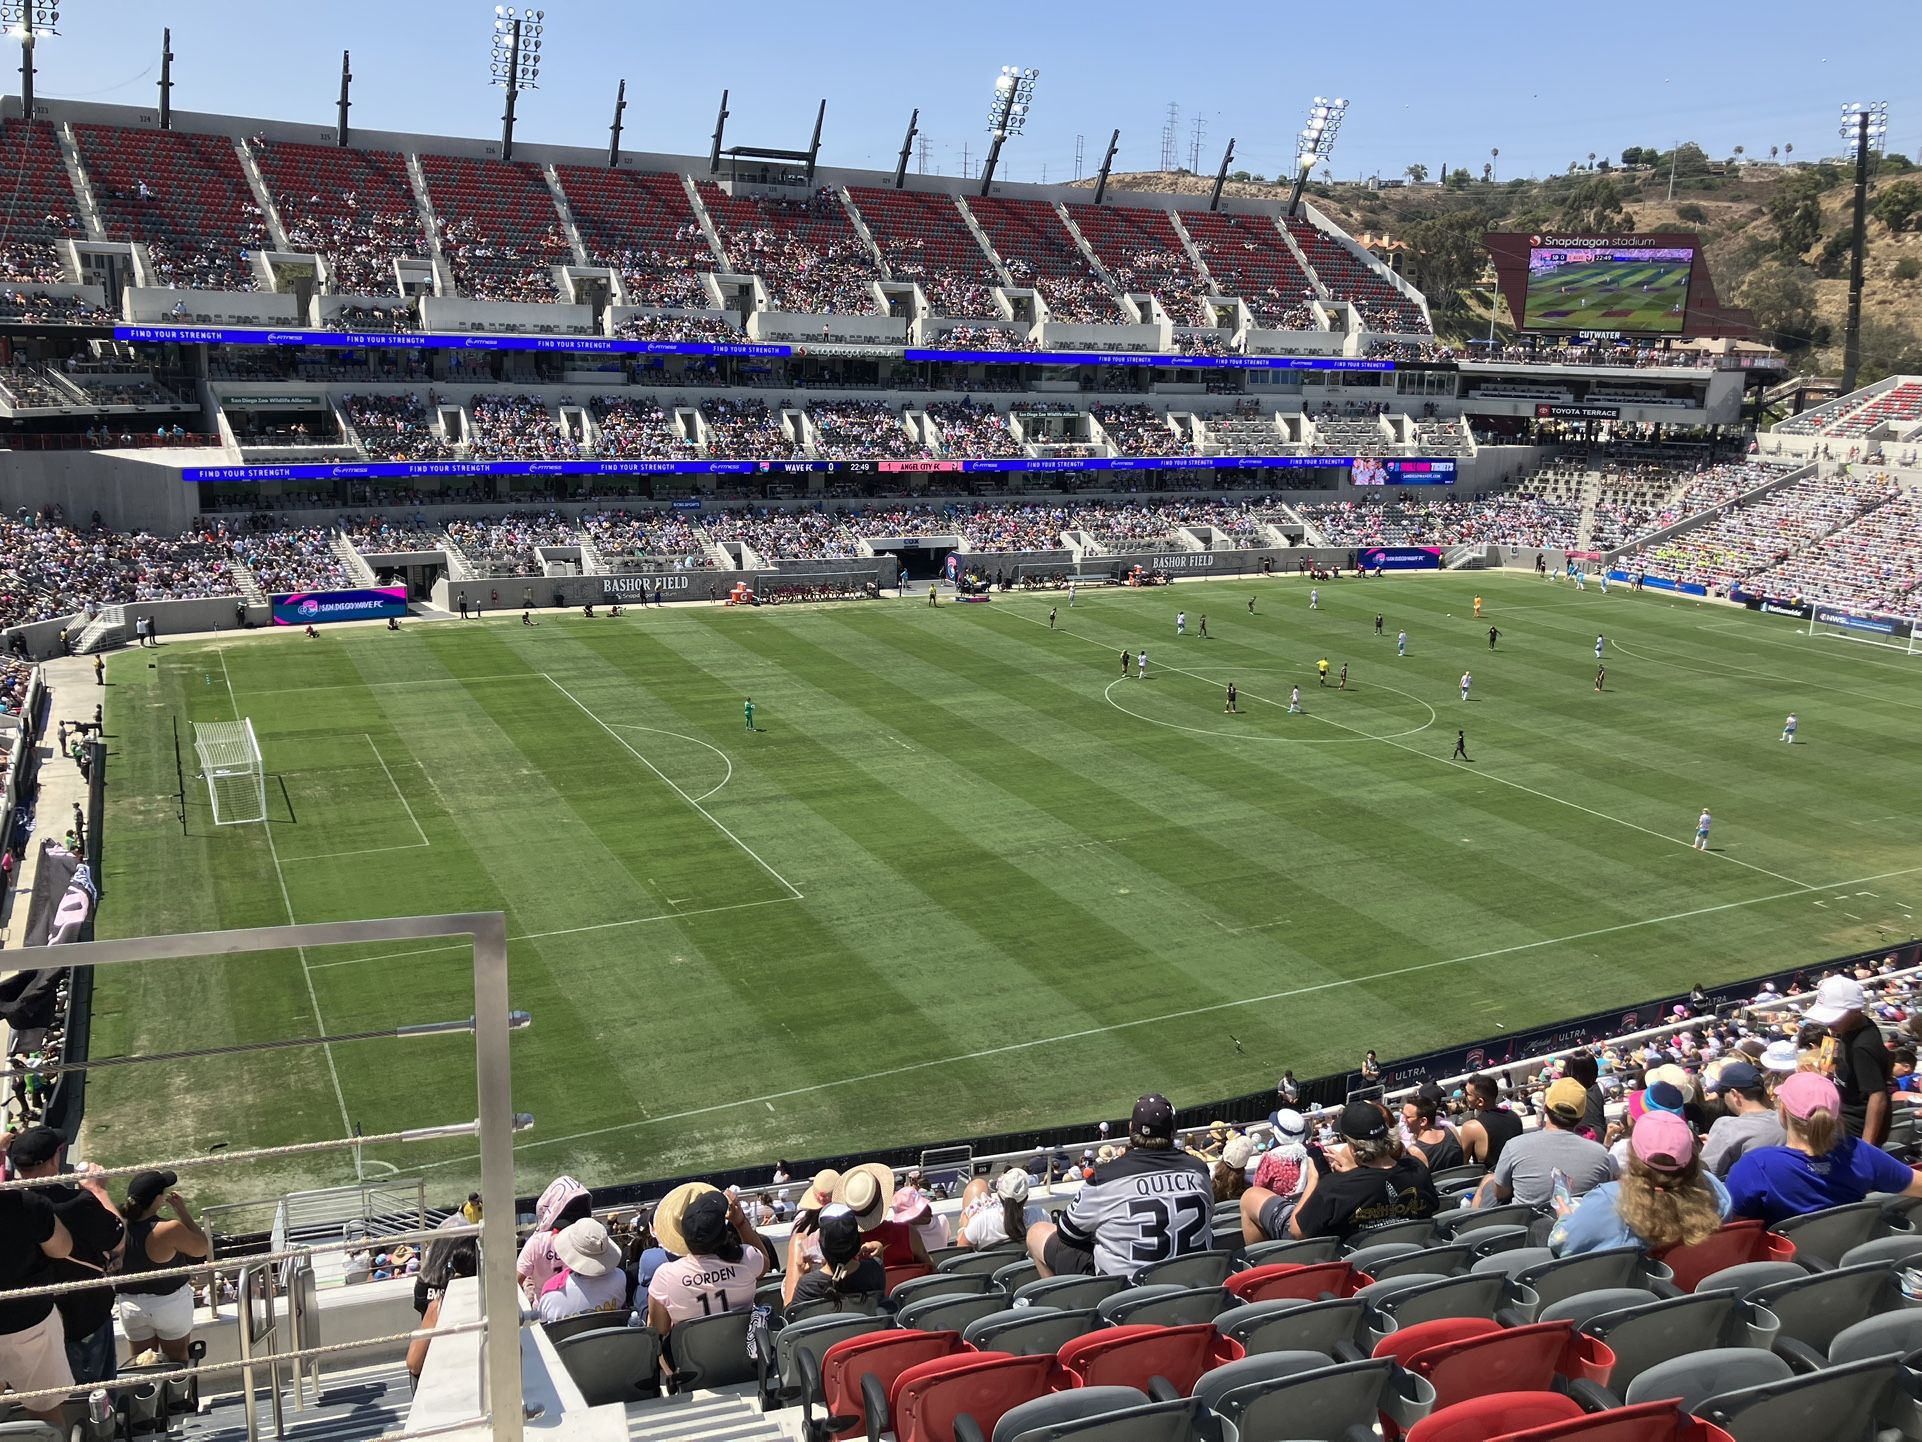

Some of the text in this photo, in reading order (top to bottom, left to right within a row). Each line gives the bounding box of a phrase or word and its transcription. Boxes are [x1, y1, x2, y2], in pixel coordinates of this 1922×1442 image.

[1544, 236, 1656, 249] Snapdragon stadium
[180, 331, 222, 339] STRENGTH
[1579, 331, 1620, 339] CUTWATER
[810, 346, 897, 357] Snapdragon stadium
[1551, 407, 1617, 417] TOYOTA TERRACE
[409, 465, 428, 473] FIND
[784, 463, 813, 472] WAVE FC
[828, 463, 834, 471] 0
[850, 463, 869, 471] 22:49
[1431, 462, 1454, 472] TICKETS
[200, 470, 220, 478] FIND
[248, 469, 290, 477] STRENGTH
[1152, 554, 1214, 569] BASHOR FIELD
[603, 578, 651, 593] BASHOR
[740, 592, 748, 601] G
[374, 599, 384, 608] FC
[1767, 604, 1803, 617] Nationwide
[1558, 1028, 1586, 1042] ULTRA
[1395, 1066, 1426, 1081] ULTRA
[1136, 1174, 1198, 1196] QUICK
[1126, 1194, 1209, 1263] 32
[682, 1265, 736, 1287] GORDEN
[696, 1288, 729, 1317] 11
